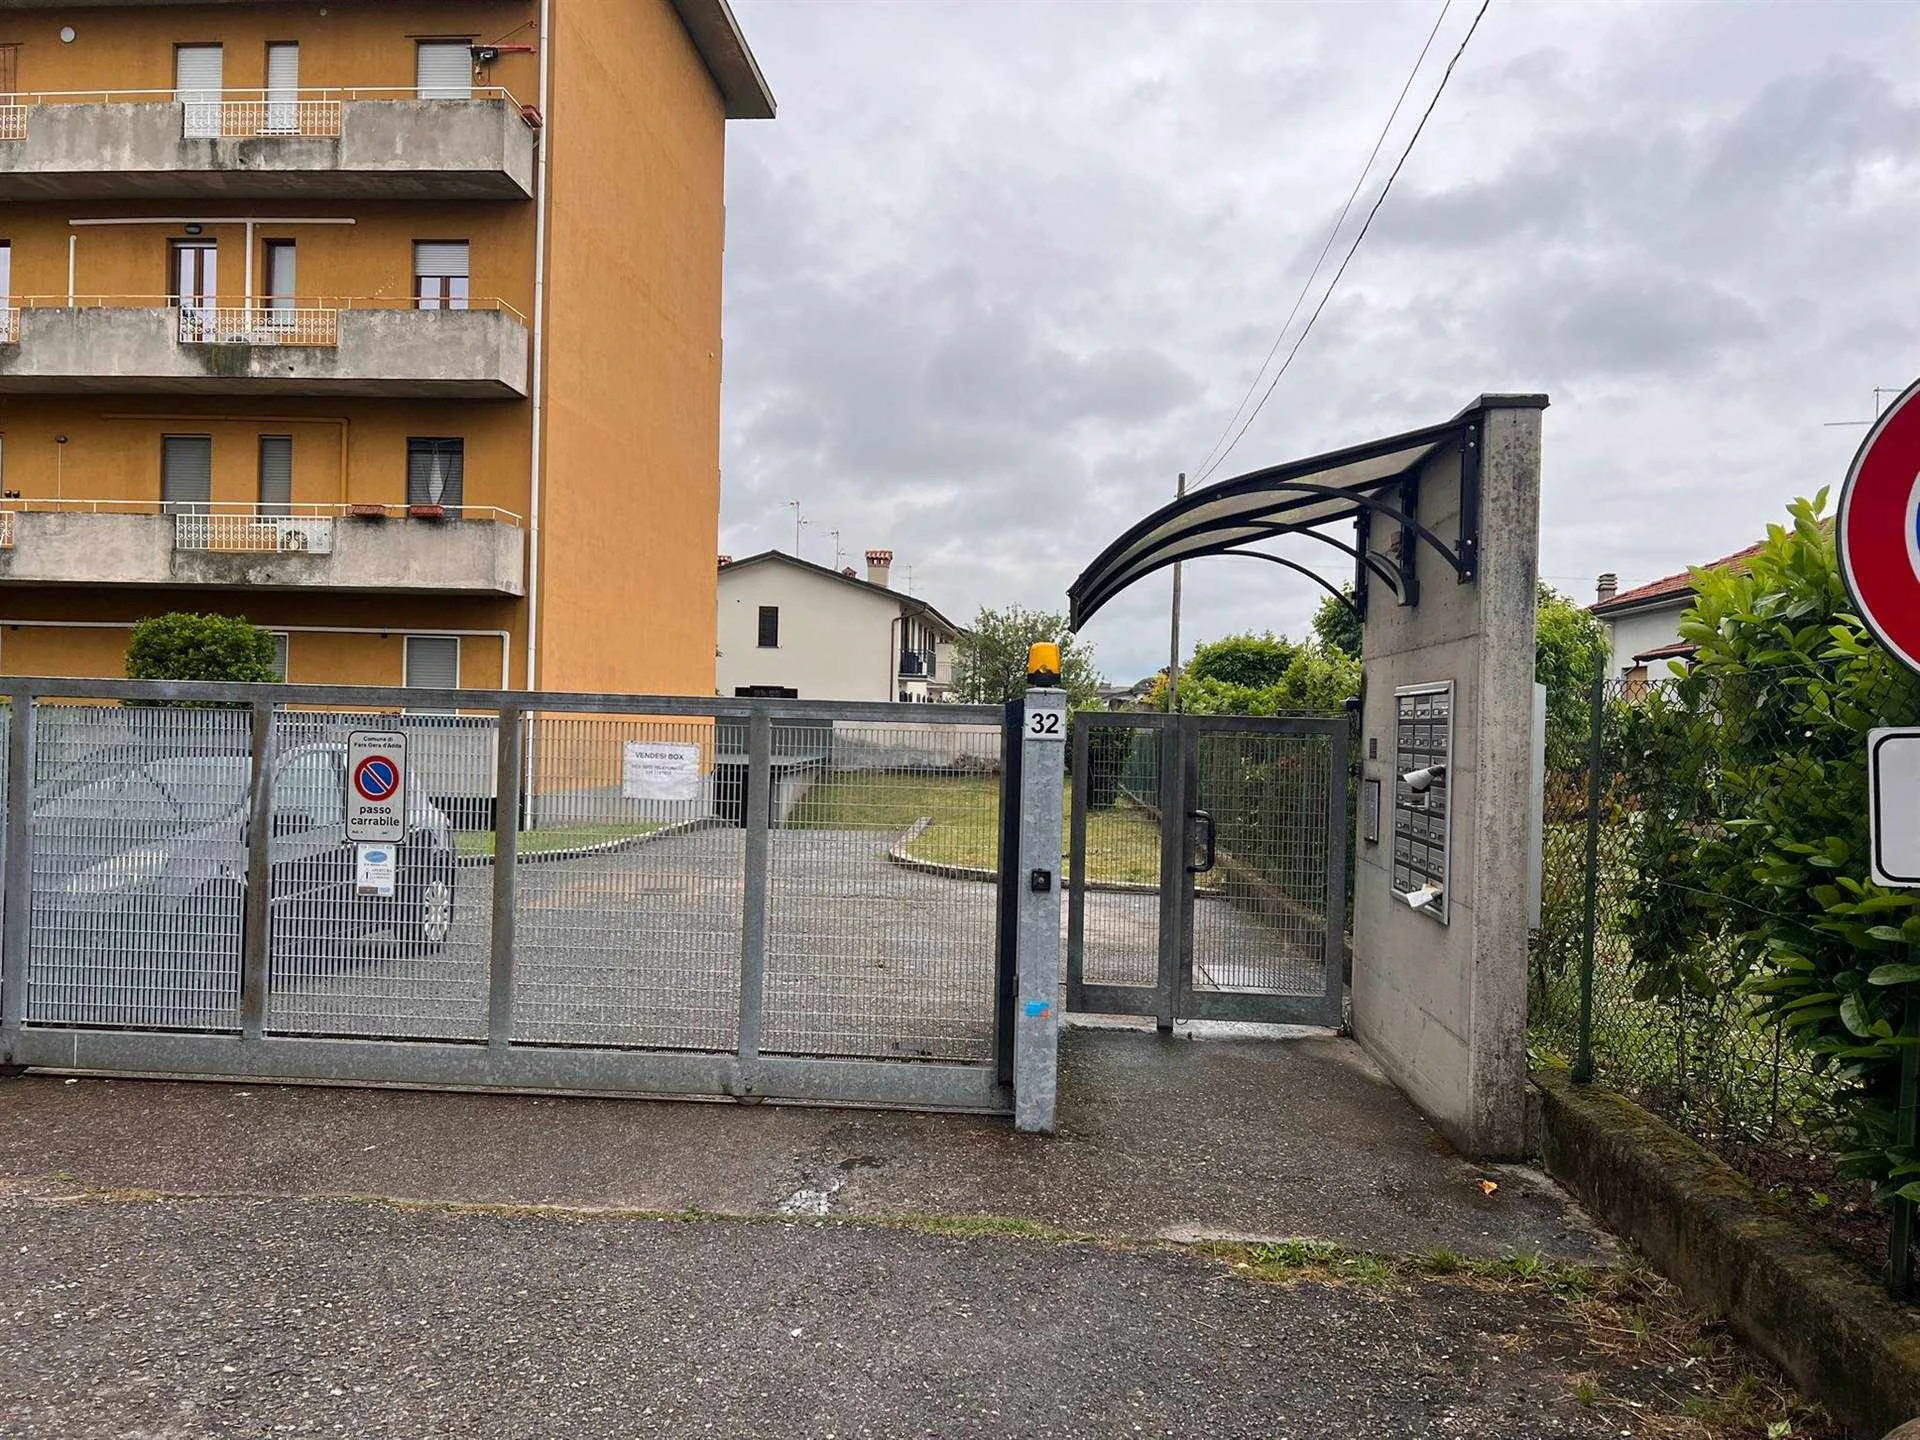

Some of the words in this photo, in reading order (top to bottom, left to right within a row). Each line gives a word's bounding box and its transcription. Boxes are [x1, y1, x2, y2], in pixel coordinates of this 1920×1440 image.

[1031, 713, 1059, 734] 32
[635, 752, 667, 760] VENDESI
[360, 806, 392, 815] passo
[351, 816, 400, 826] carrabile
